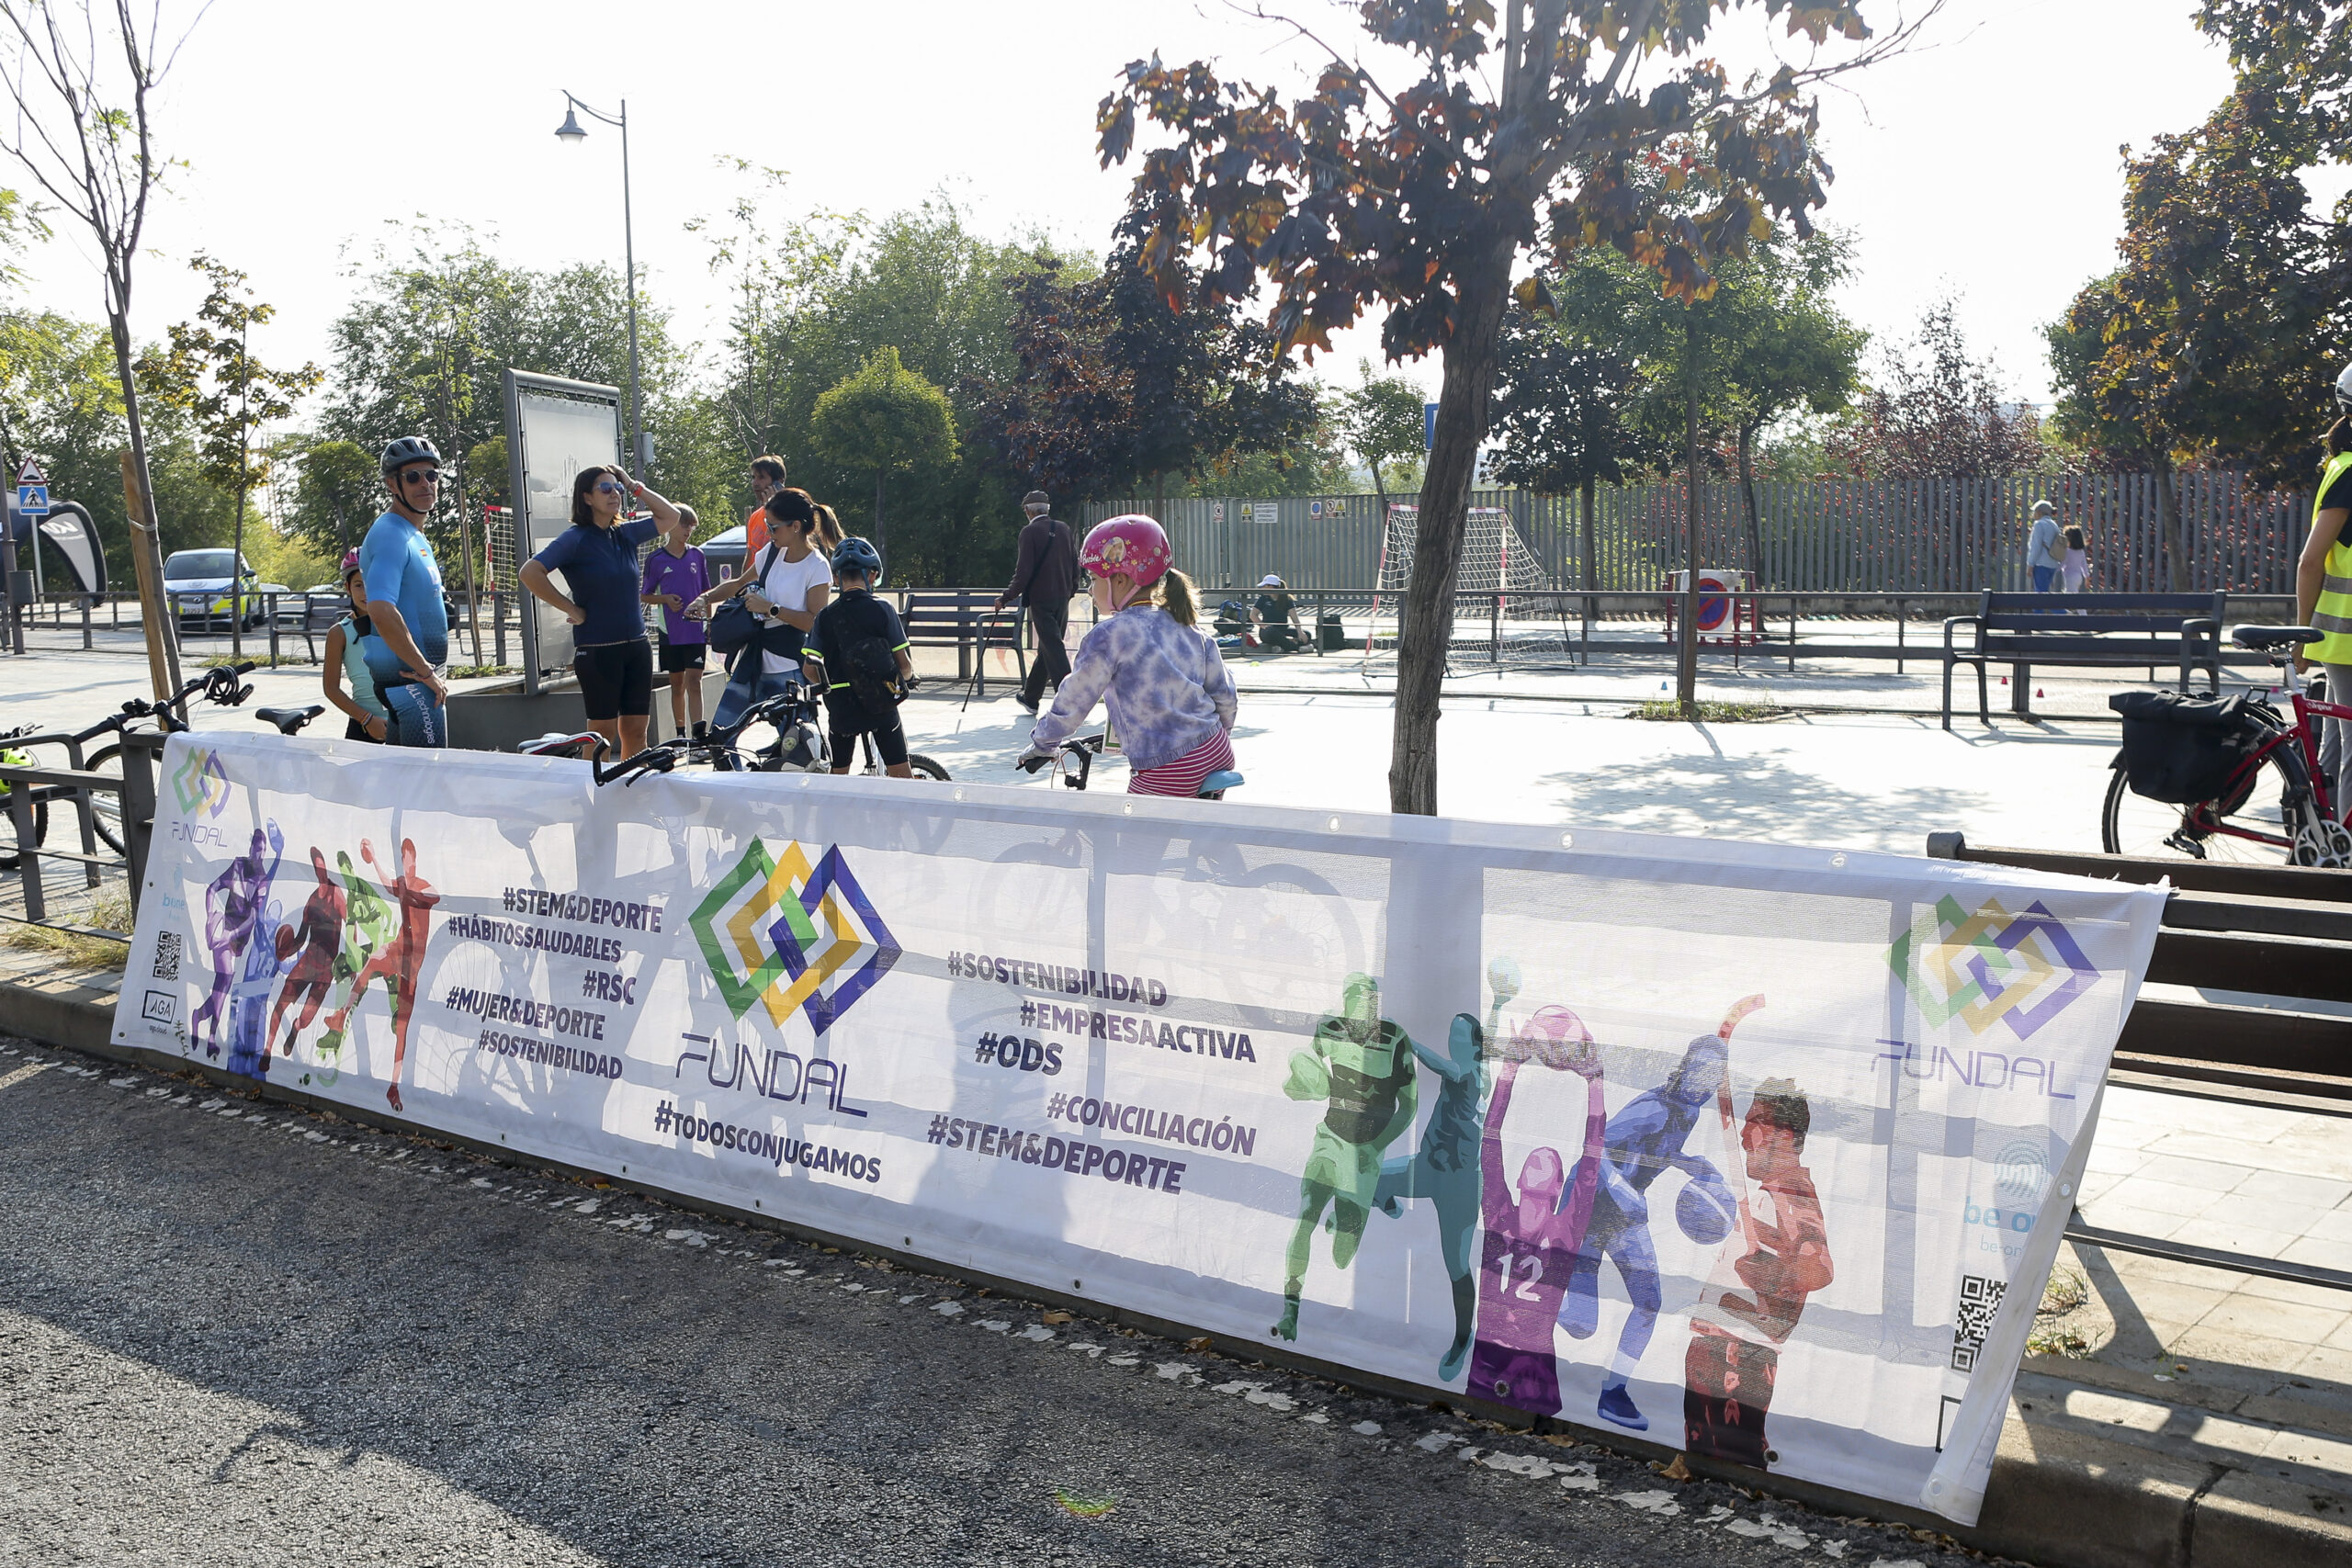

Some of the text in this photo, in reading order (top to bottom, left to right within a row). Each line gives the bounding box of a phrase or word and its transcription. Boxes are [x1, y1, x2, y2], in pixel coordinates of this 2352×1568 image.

[415, 695, 435, 744] Technologies
[503, 886, 663, 933] #STEM&DEPORTE
[448, 913, 622, 963] #HÁBITOSSALUDABLES
[582, 970, 637, 1005] #RSC
[947, 950, 1168, 1007] #SOSTENIBILIDAD
[446, 986, 605, 1042] #MUJER&DEPORTE
[1020, 1000, 1257, 1063] #EMPRESAACTIVA
[479, 1029, 623, 1080] #SOSTENIBILIDAD
[675, 1032, 867, 1118] FUNDAL
[975, 1031, 1064, 1076] #ODS
[1871, 1038, 2075, 1100] FUNDAL
[654, 1100, 881, 1183] #TODOSCONJUGAMOS
[1046, 1091, 1257, 1156] #CONCILIACIÓN
[927, 1113, 1187, 1196] #STEM&DEPORTE
[1963, 1195, 2036, 1233] be o
[1497, 1253, 1544, 1302] 12
